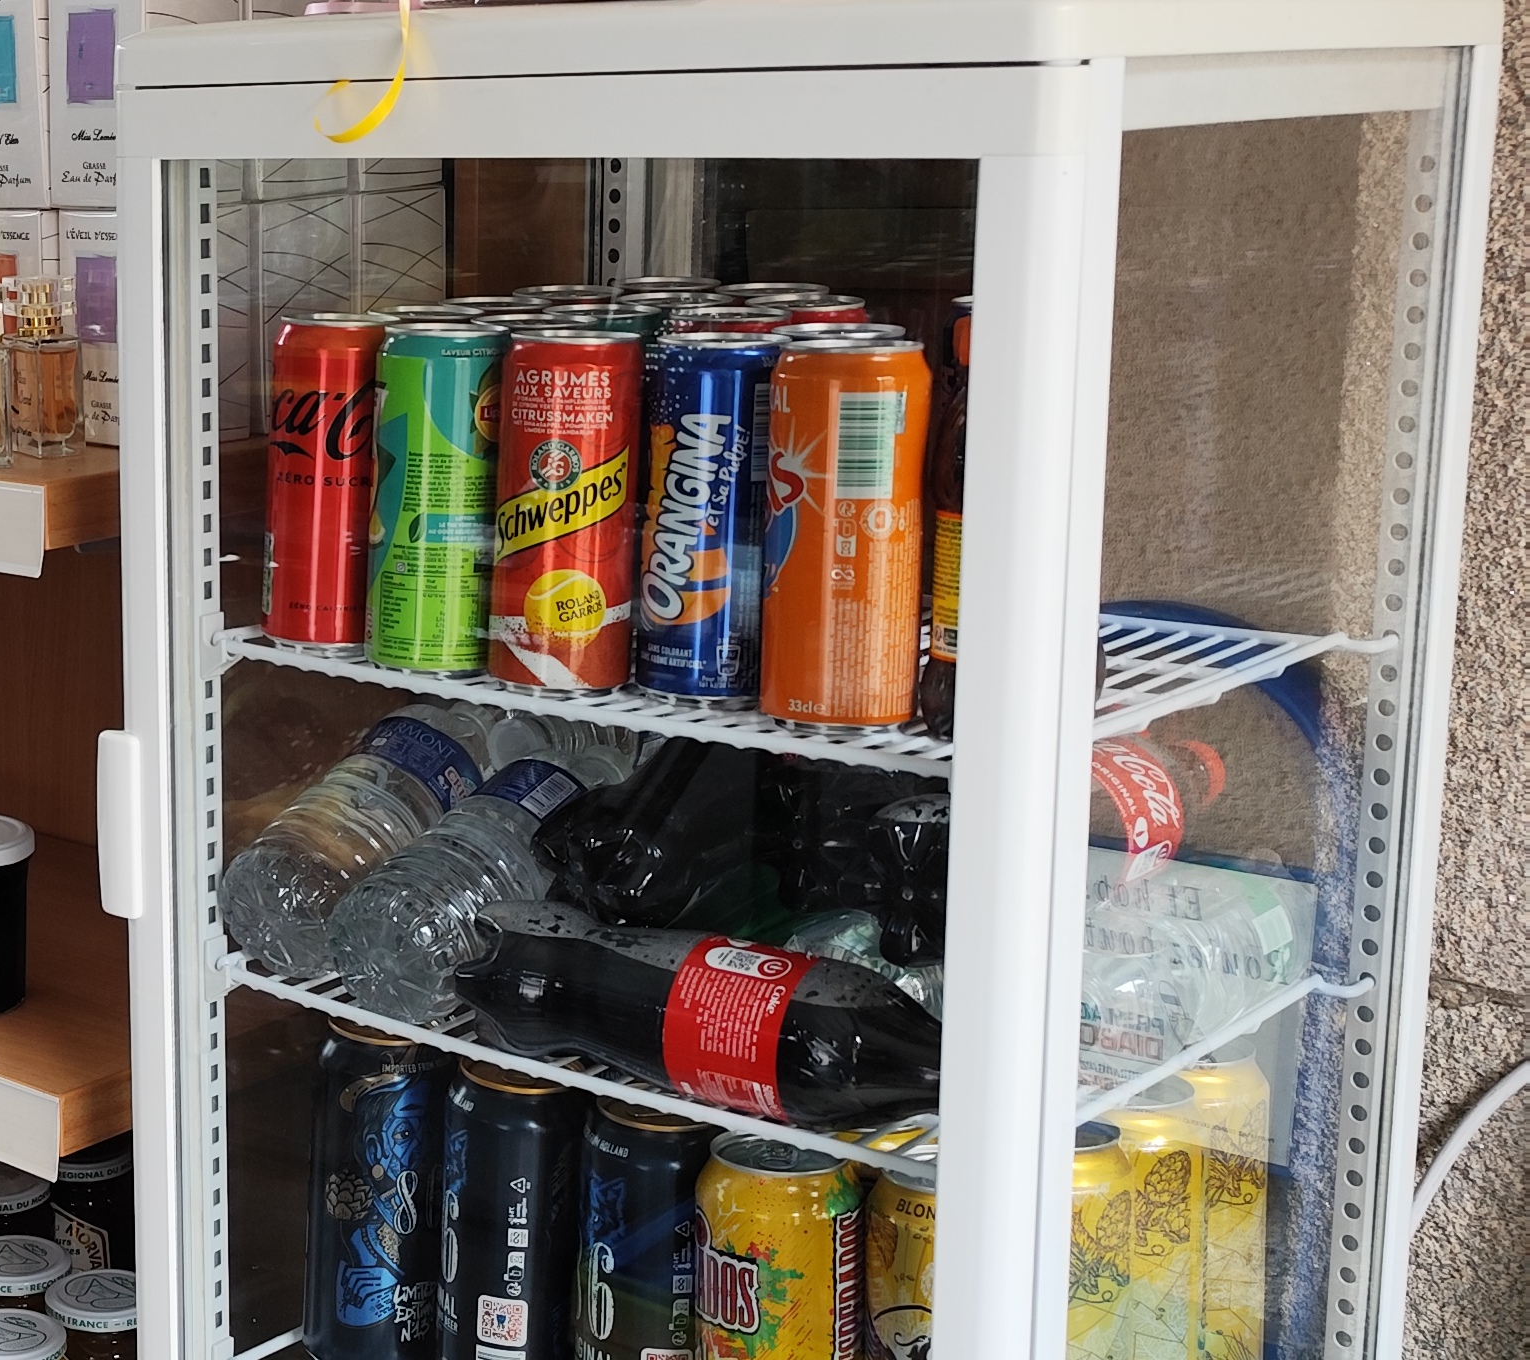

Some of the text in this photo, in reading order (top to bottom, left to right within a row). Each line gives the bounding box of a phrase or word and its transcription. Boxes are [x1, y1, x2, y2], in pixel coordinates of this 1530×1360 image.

[515, 369, 610, 387] AGRUMES
[513, 385, 612, 399] AUX SAVEURS
[511, 407, 614, 423] CITRUSSMAKEN
[497, 468, 623, 557] Schweppes
[641, 414, 732, 621] ORANGINA
[555, 590, 601, 611] ROLAND
[558, 600, 603, 623] GARROS
